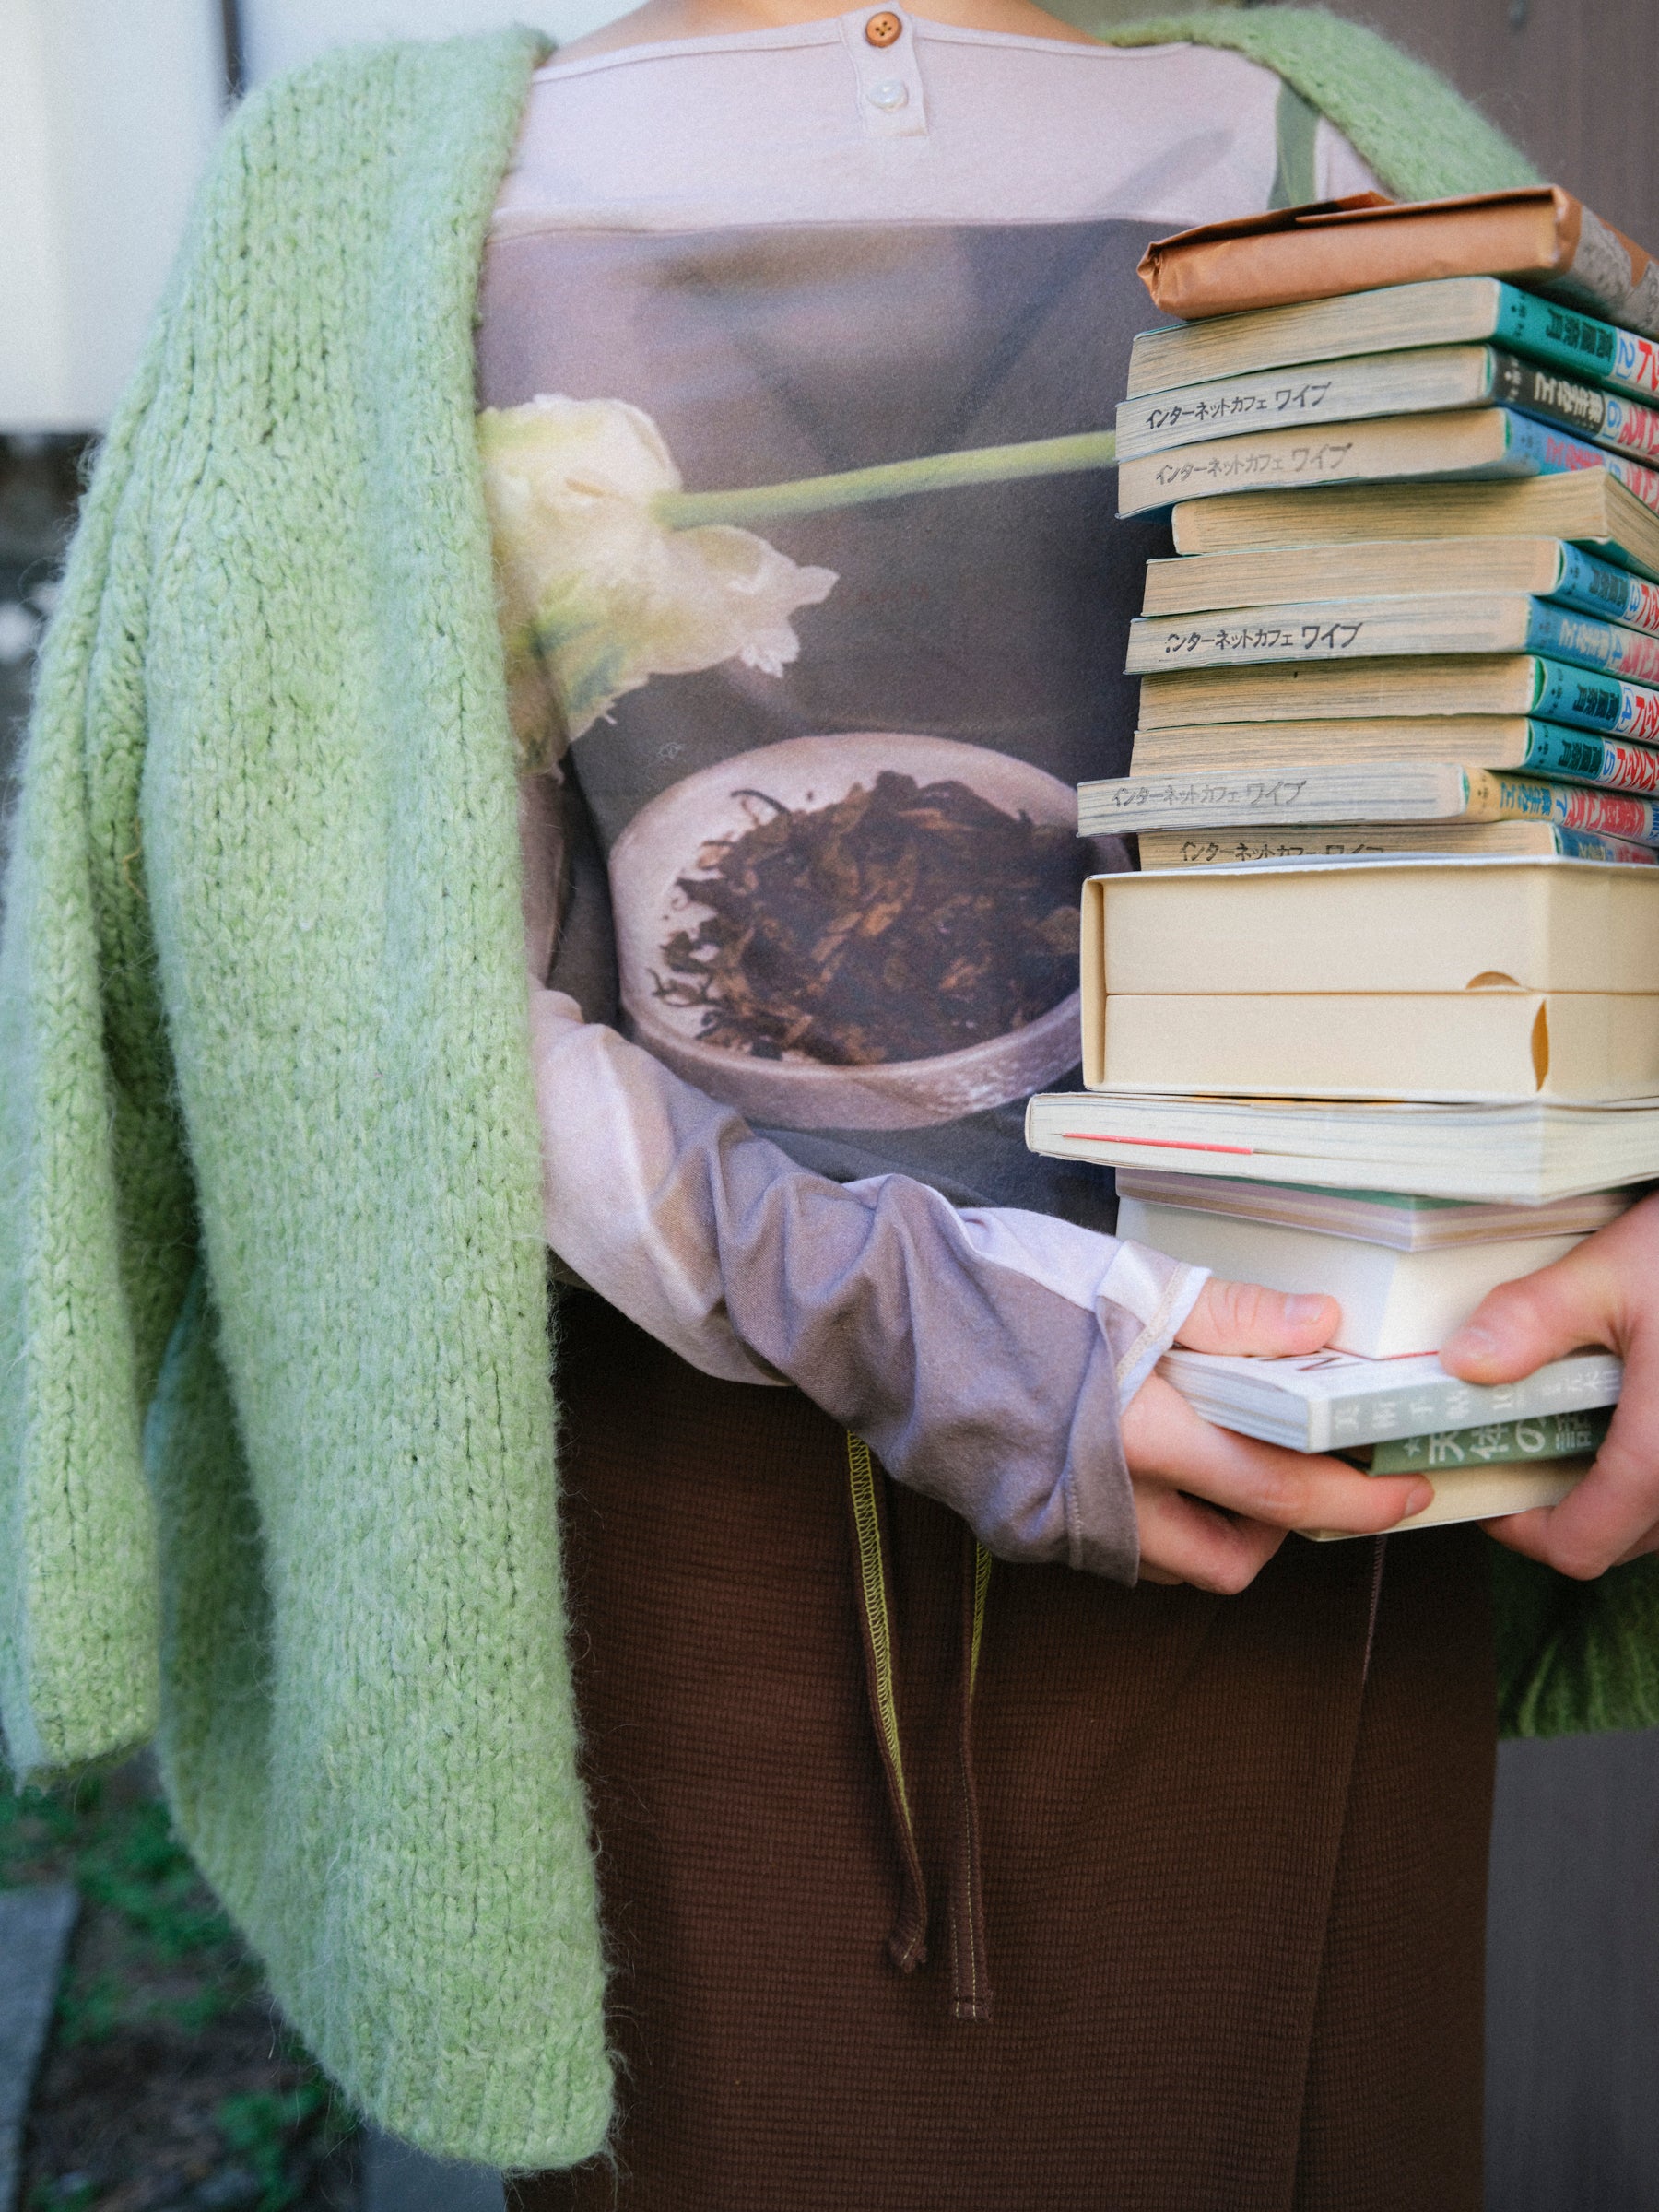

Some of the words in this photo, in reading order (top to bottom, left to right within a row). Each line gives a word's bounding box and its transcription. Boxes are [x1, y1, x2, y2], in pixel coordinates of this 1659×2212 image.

[1146, 396, 1267, 429] インターネットカフェ
[1156, 454, 1283, 485] インターネットカフェ
[1112, 784, 1241, 807] インターネットカフェ
[1181, 841, 1316, 862] インターネットカフ
